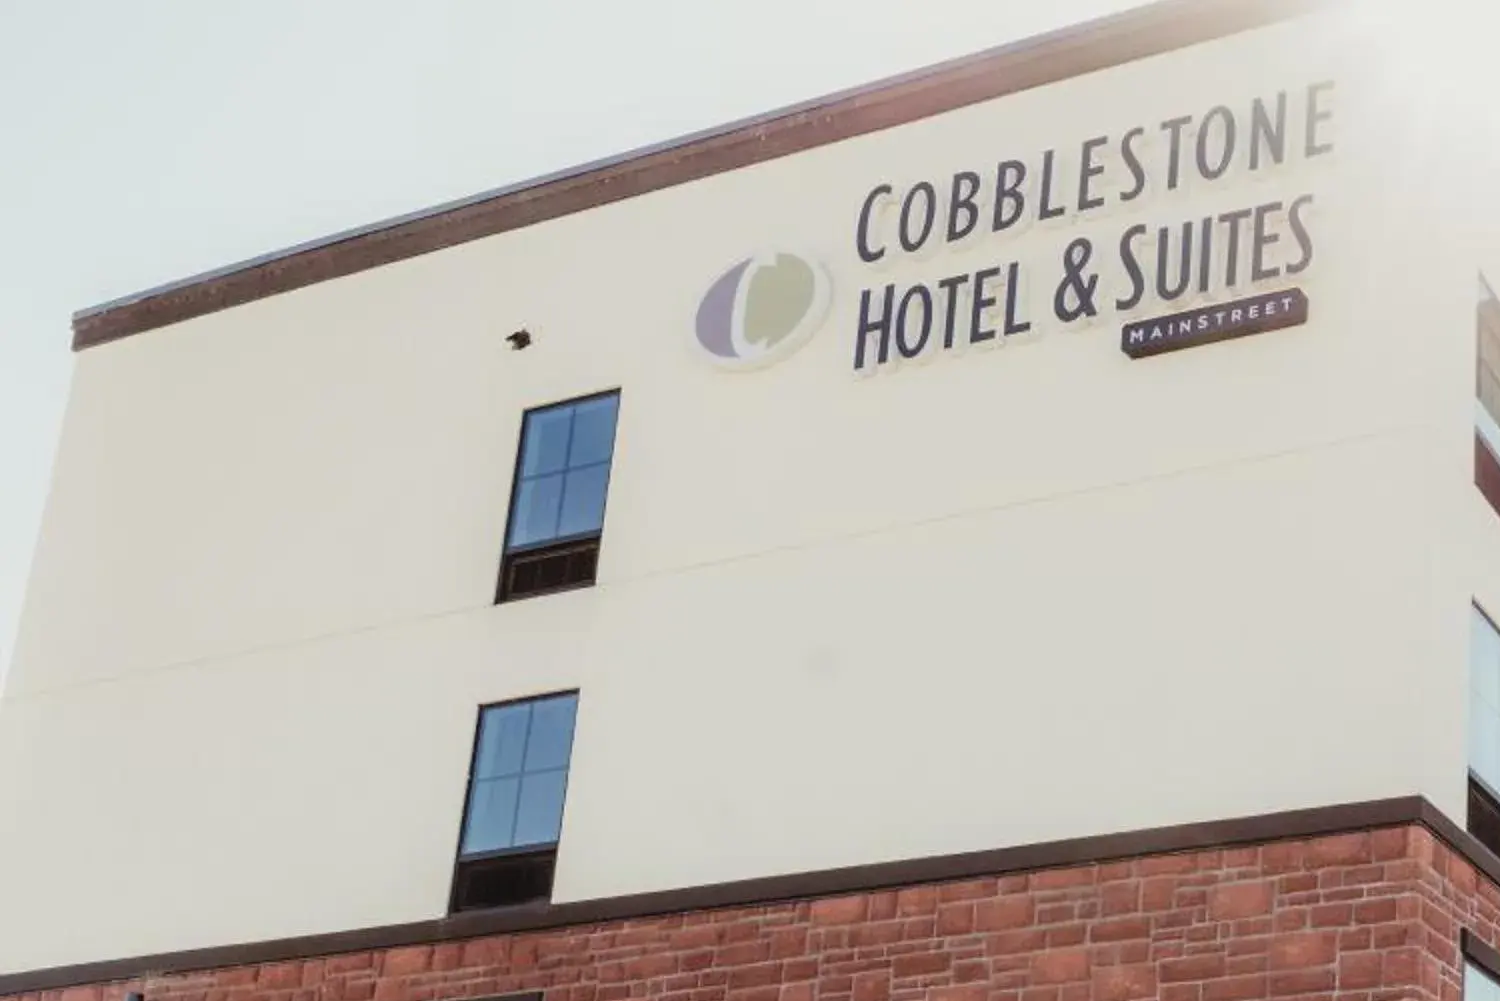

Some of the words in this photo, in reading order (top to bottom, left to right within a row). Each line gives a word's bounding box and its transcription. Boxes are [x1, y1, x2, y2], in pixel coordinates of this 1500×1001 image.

[855, 80, 1337, 263] COBBLESTONE
[853, 262, 1032, 370] HOTEL
[1054, 236, 1100, 323] &
[1115, 194, 1315, 312] SUITES
[1129, 297, 1295, 344] MAINSTREET
